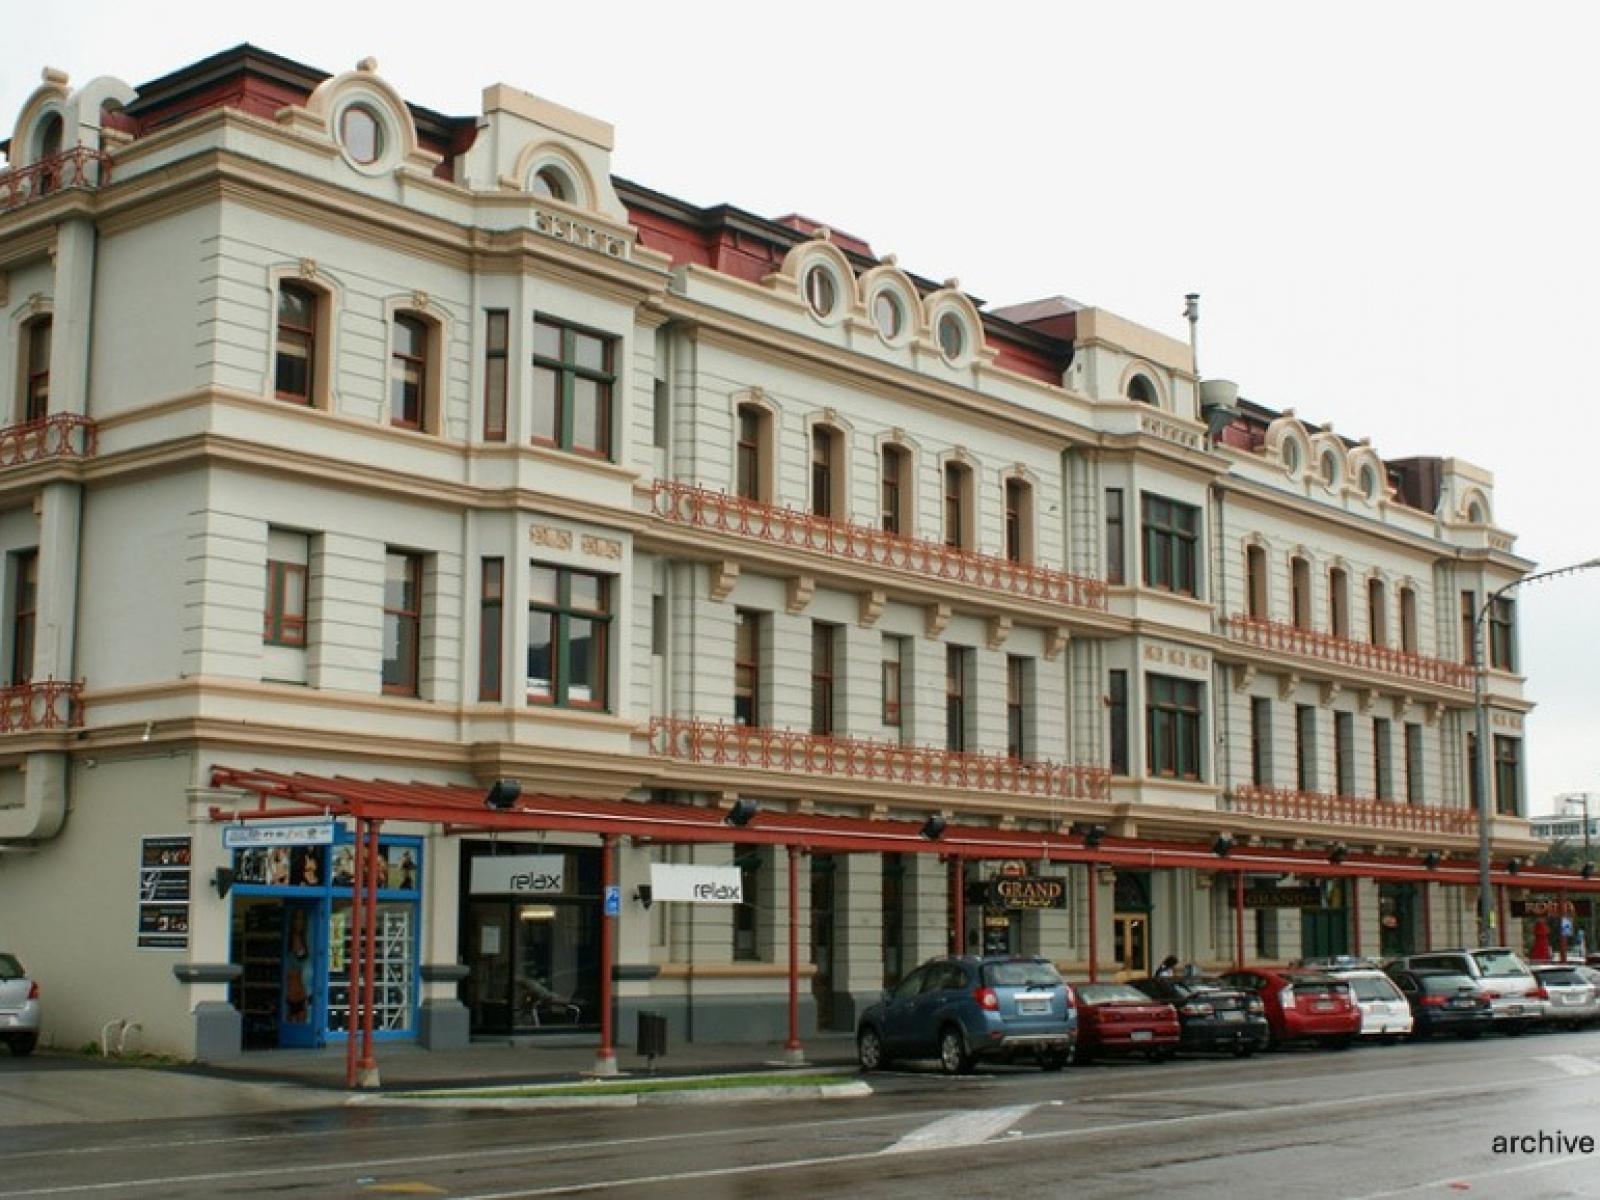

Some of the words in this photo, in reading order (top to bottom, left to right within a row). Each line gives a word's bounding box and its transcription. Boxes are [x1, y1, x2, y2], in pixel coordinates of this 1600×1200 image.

[510, 872, 561, 889] relax
[997, 881, 1061, 897] GRAND
[693, 882, 740, 899] relax
